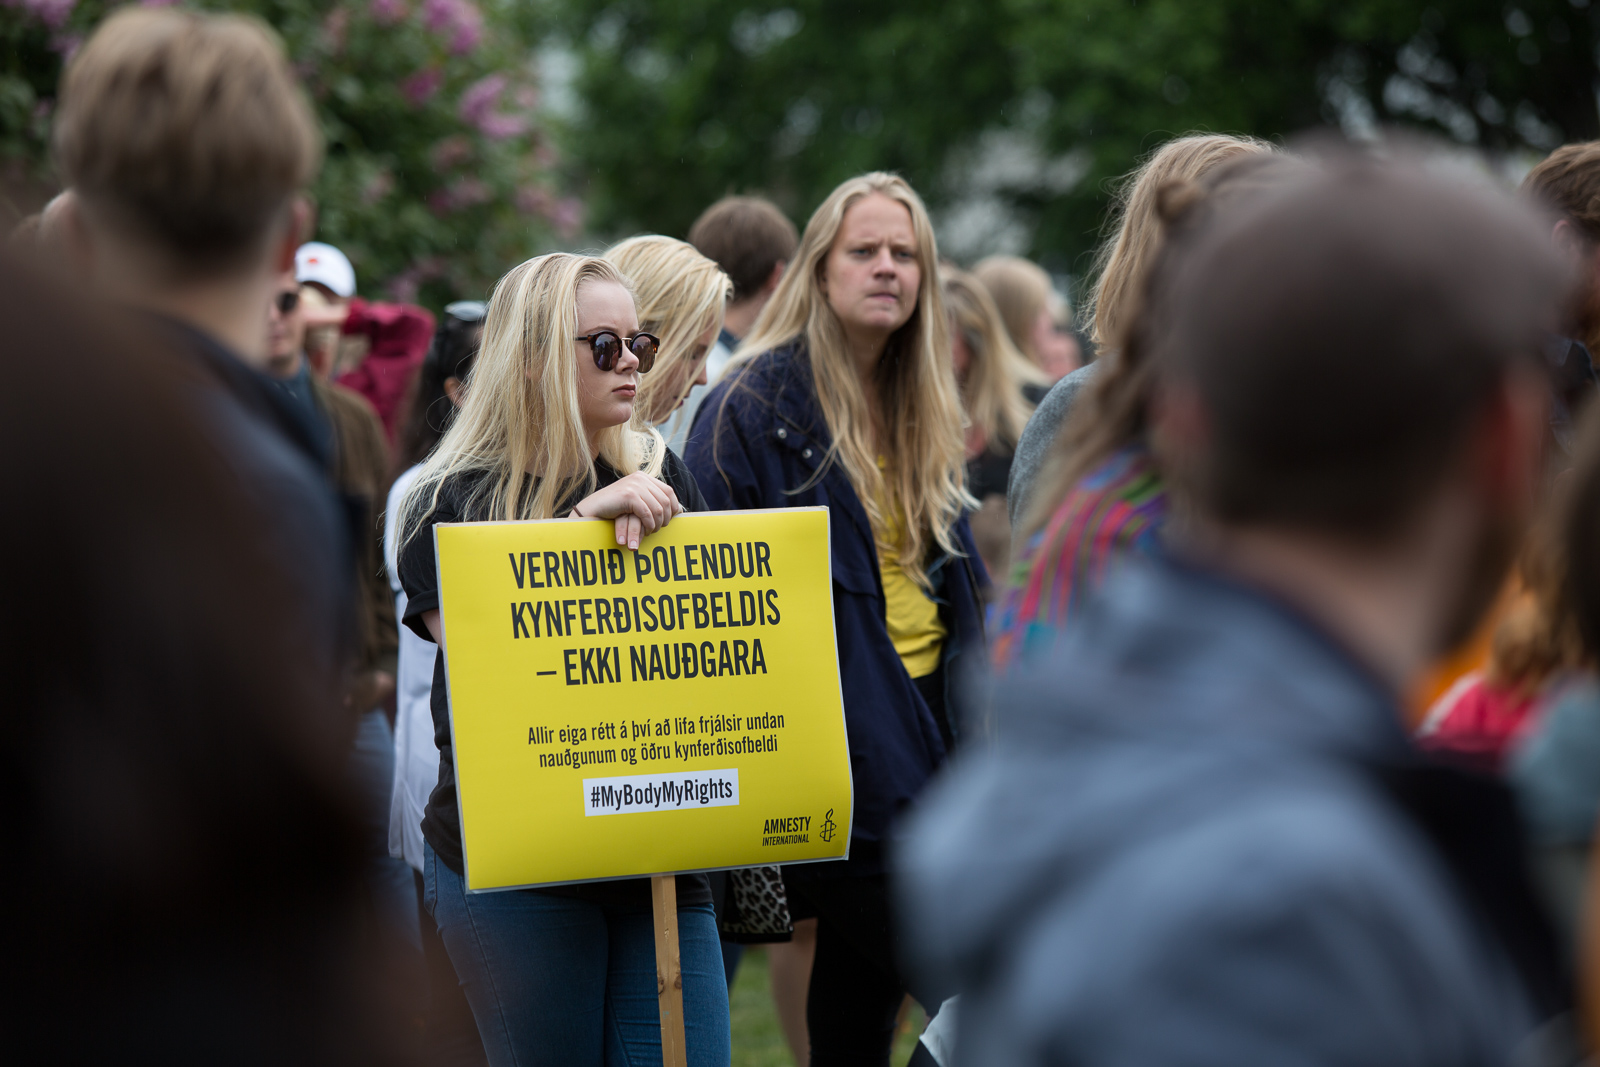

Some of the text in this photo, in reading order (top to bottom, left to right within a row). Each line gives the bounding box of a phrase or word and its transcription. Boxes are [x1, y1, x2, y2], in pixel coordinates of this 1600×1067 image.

[508, 541, 773, 589] VERNDIÐ ÞOLENDUR
[511, 588, 781, 639] KYNFERÐISOFBELDIS
[563, 647, 622, 686] EKKI
[629, 638, 768, 682] NAUÐGARA
[528, 712, 785, 745] Allir eiga rétt á því að lifa frjálsir undan
[539, 734, 778, 770] nauðgunum og öðru kynferðisofbeldi
[590, 777, 733, 811] #MyBodyMyRights
[762, 833, 810, 847] INTERNATIONAL
[763, 816, 812, 835] AMNESTY
